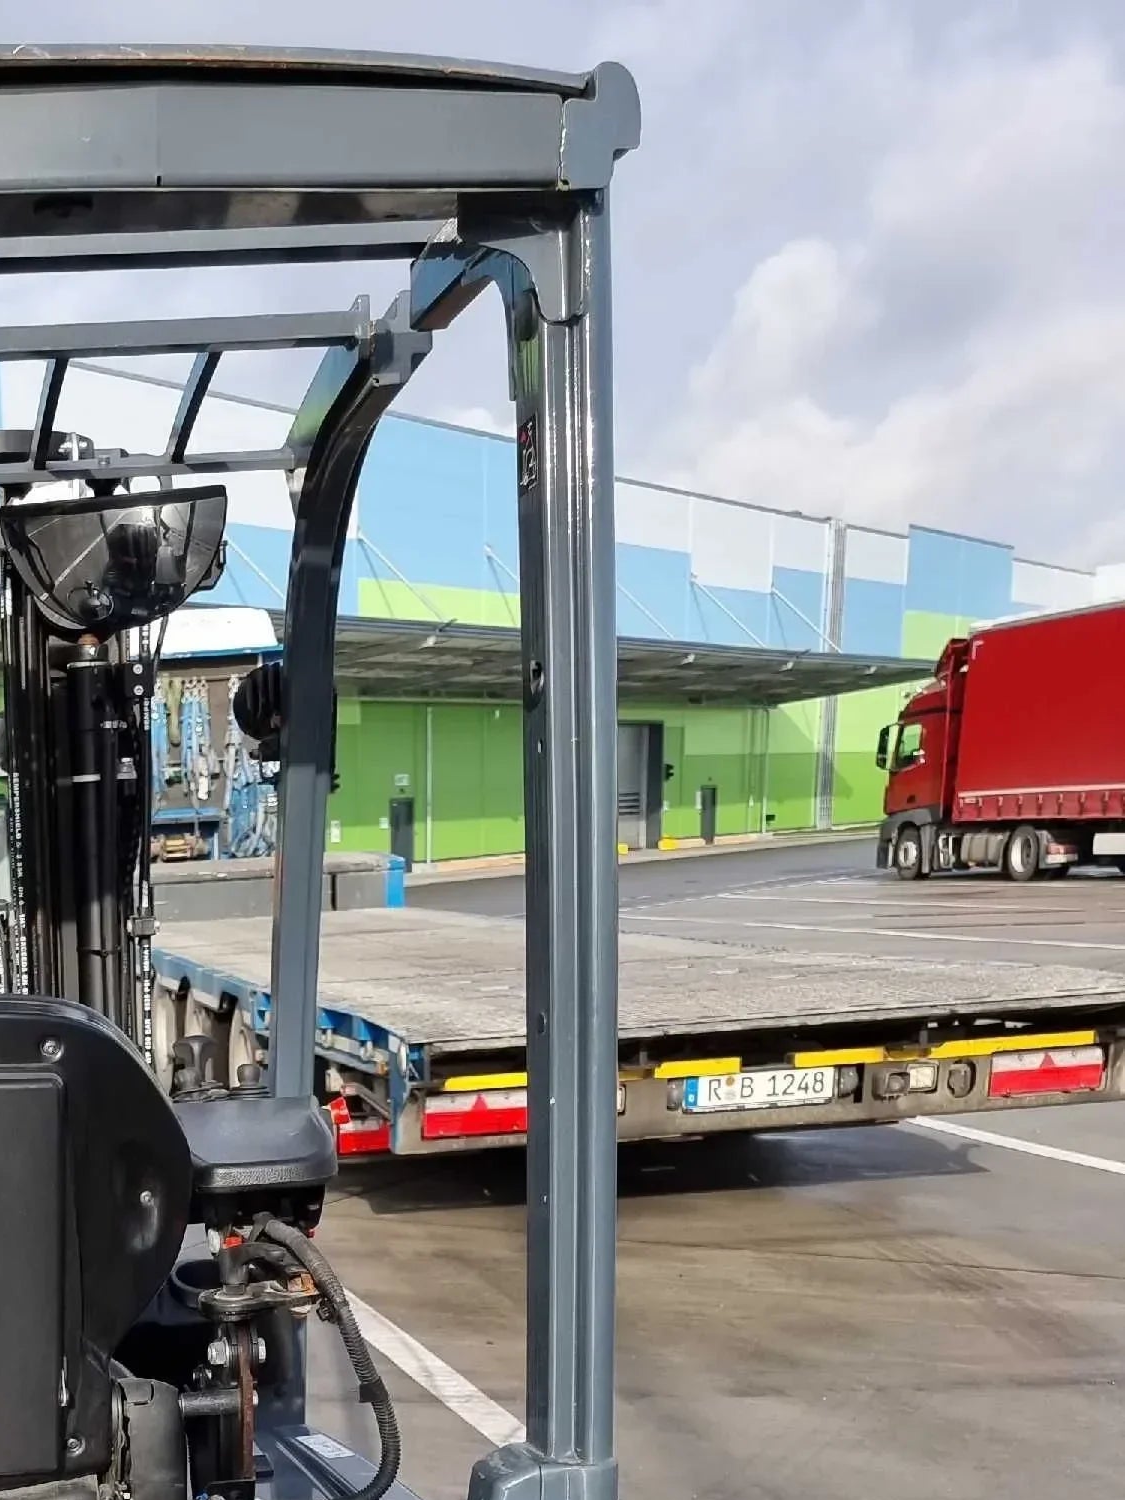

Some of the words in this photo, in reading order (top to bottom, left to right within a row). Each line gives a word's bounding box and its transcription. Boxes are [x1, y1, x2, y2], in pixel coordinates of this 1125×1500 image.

[708, 1078, 722, 1102] R
[740, 1076, 754, 1098] B
[766, 1071, 825, 1097] 1248
